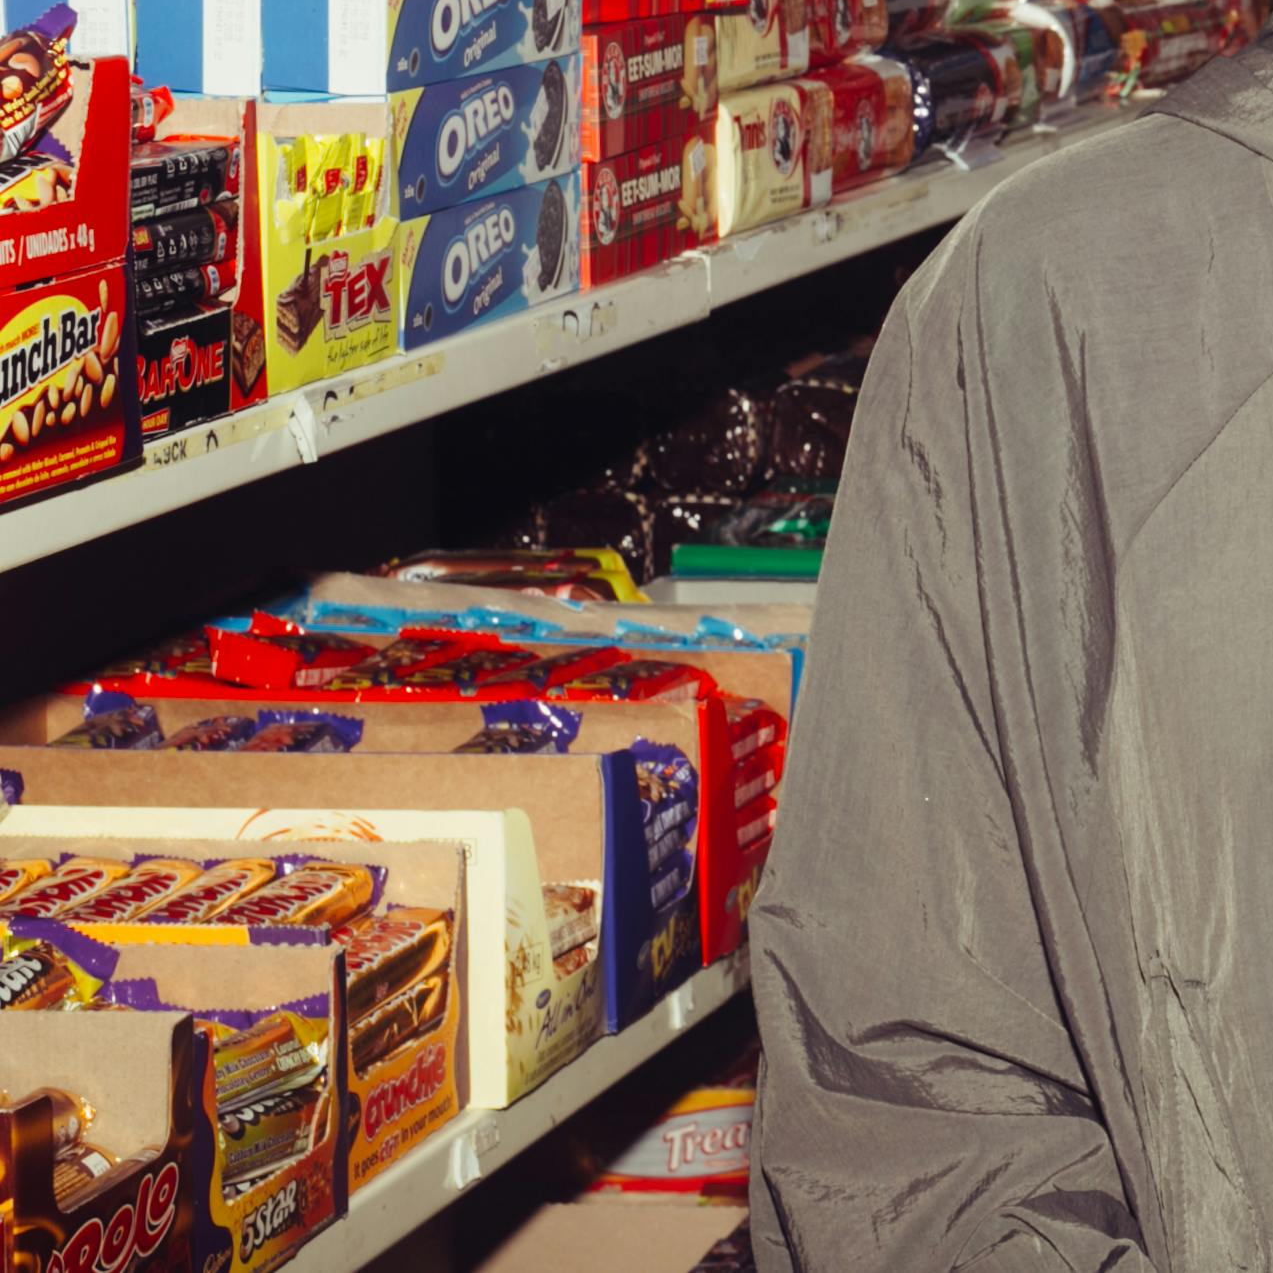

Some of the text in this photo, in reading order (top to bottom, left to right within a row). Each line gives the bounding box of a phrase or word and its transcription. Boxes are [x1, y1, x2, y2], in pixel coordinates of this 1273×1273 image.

[464, 20, 497, 67] Original
[628, 44, 683, 85] EET-SUM-MOR
[438, 85, 514, 177] OREO
[468, 142, 500, 190] Original
[621, 166, 680, 207] EET-SUM-MOR
[26, 227, 68, 260] UNIDADES
[444, 208, 515, 303] OREO
[324, 255, 391, 326] TEX
[474, 266, 503, 315] Original
[61, 308, 100, 358] Bar
